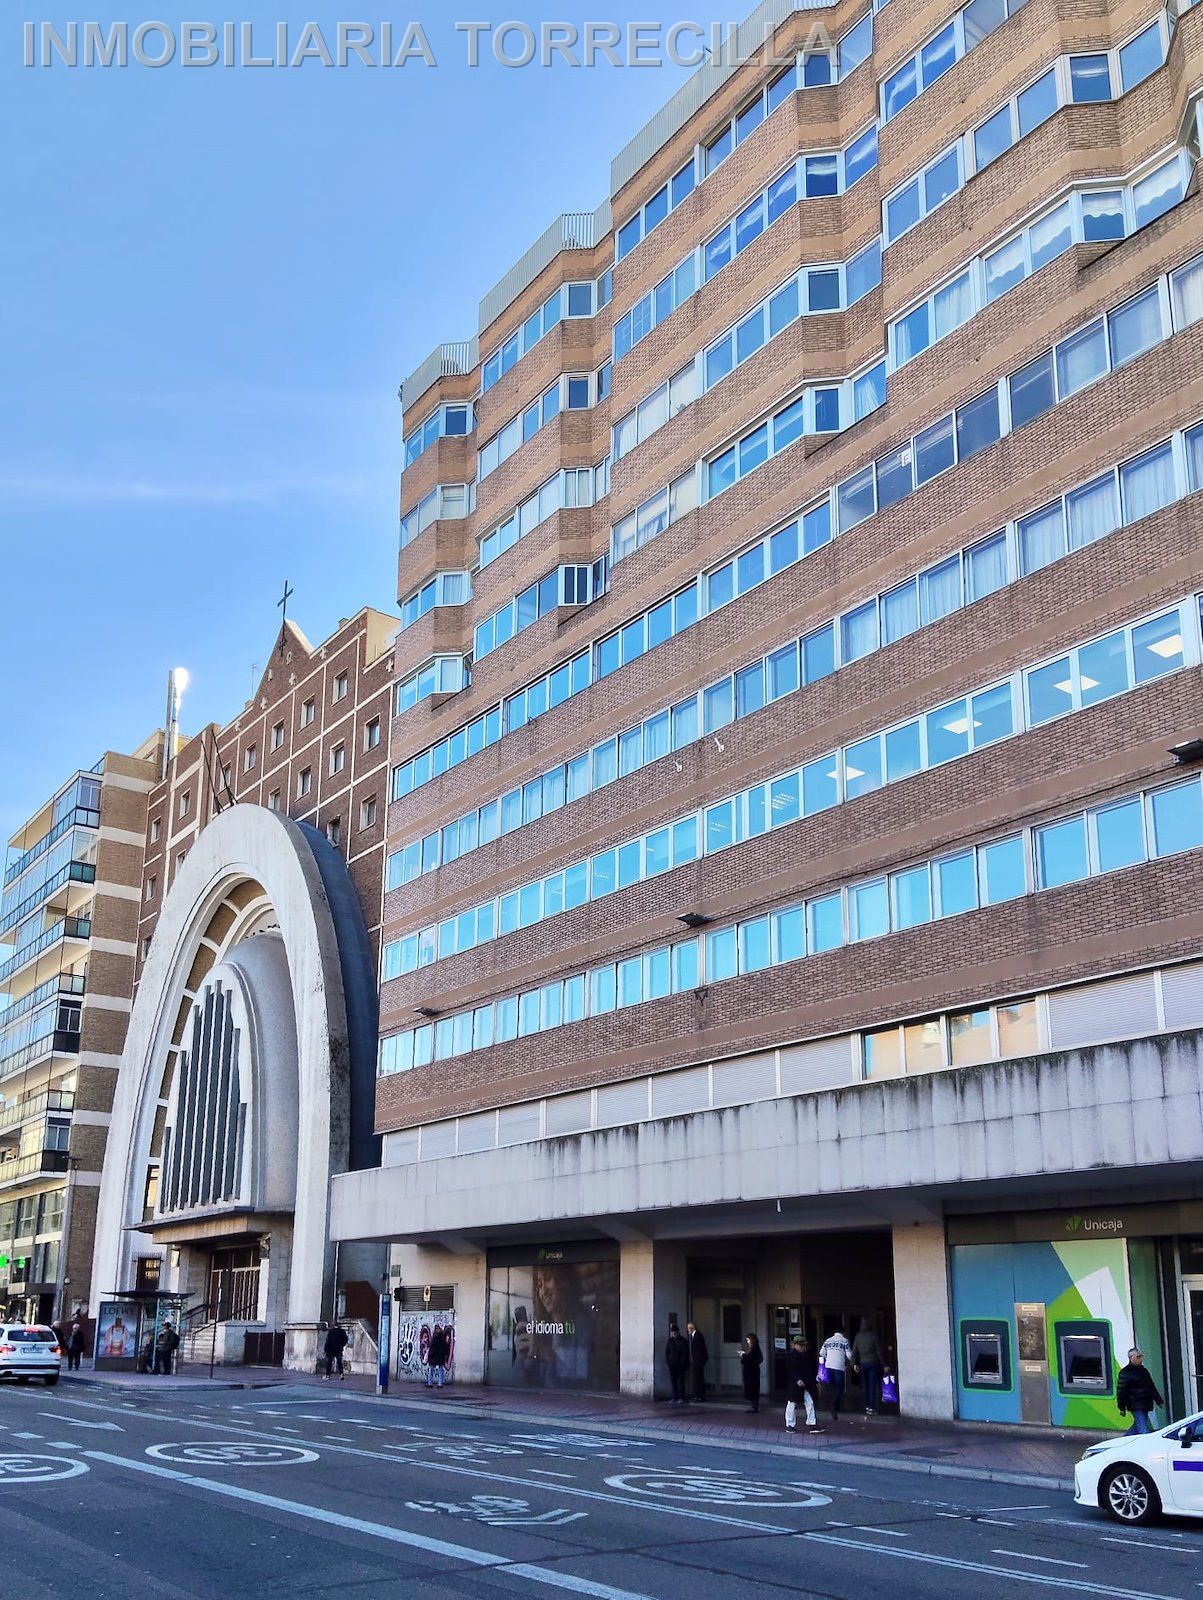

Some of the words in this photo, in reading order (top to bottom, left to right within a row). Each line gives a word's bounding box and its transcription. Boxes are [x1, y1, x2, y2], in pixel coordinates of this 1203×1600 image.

[1084, 1218, 1124, 1232] Unicaja
[526, 1320, 534, 1334] el
[535, 1320, 564, 1334] idioma
[646, 1479, 783, 1500] 30
